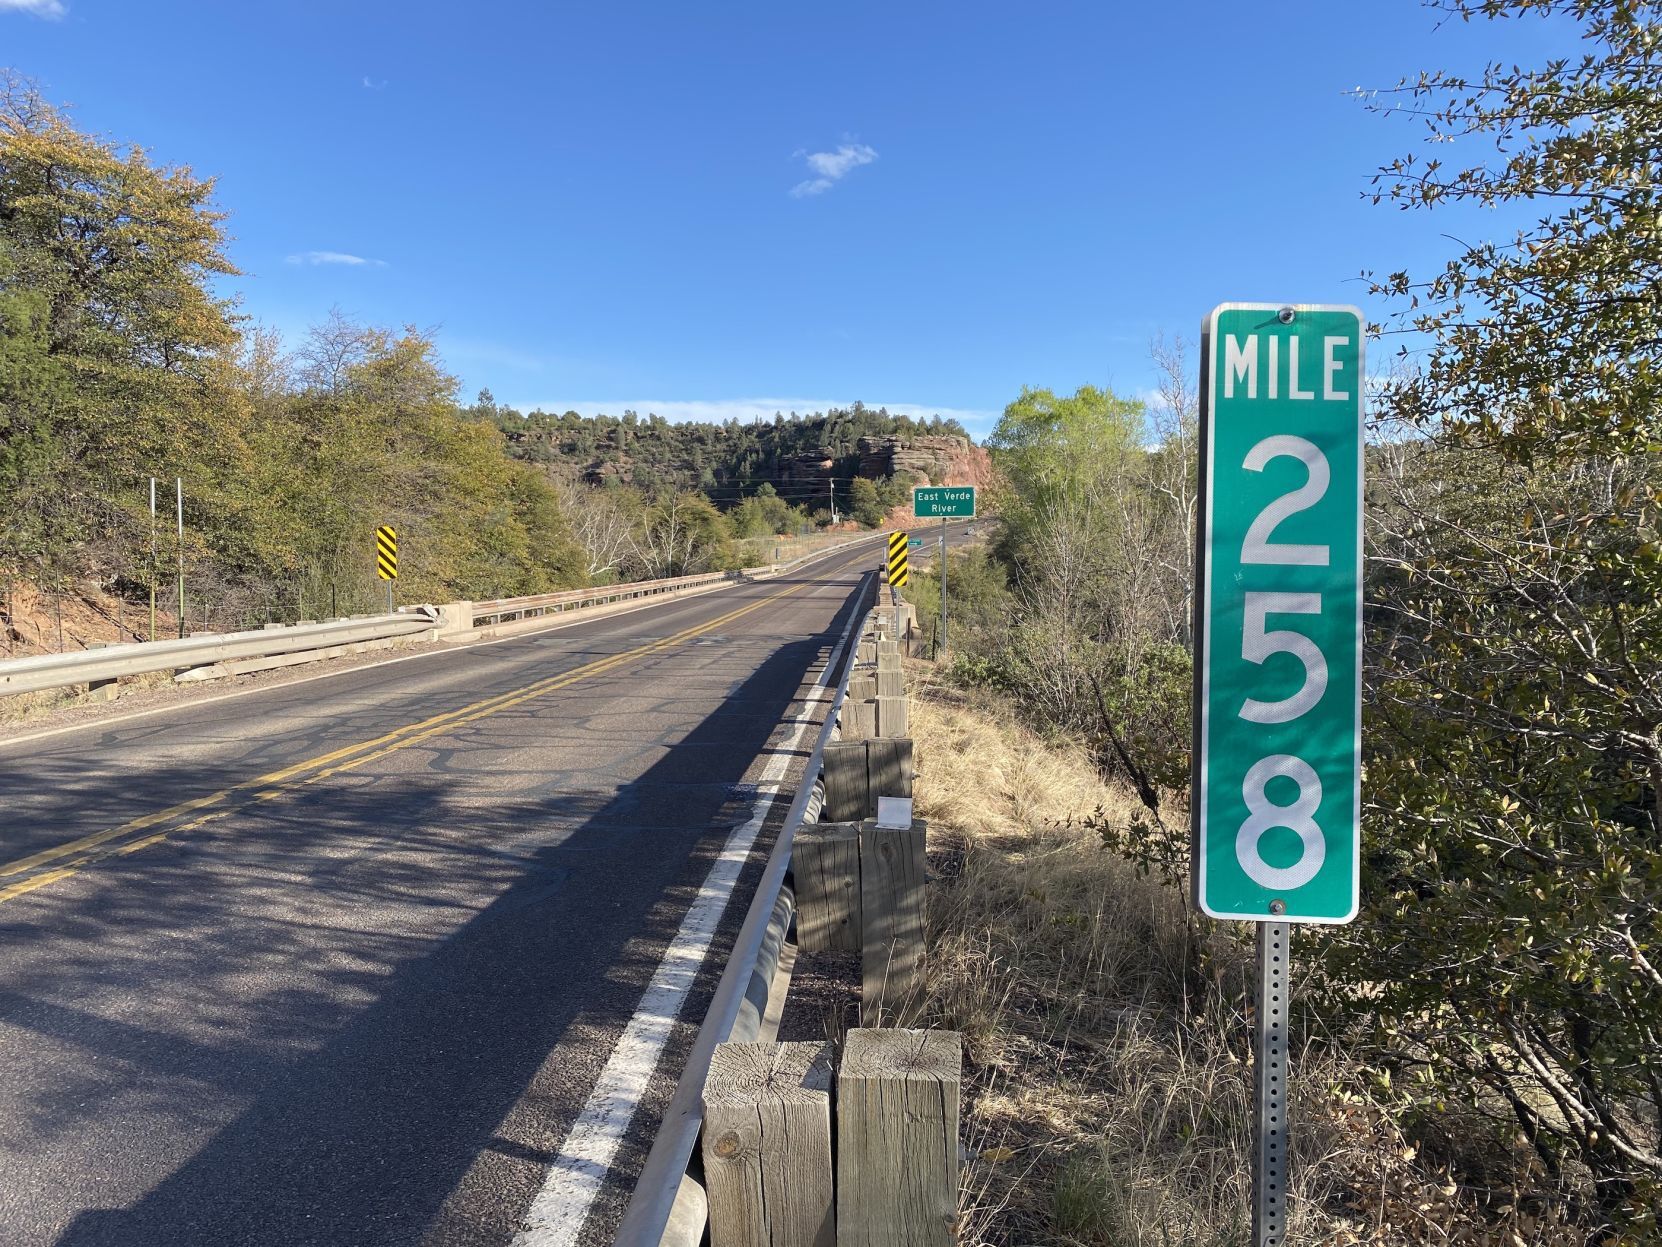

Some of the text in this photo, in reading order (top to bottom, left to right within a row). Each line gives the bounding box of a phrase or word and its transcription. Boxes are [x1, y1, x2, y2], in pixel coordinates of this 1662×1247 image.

[1224, 334, 1350, 401] MILE
[918, 492, 971, 501] East Verde
[931, 504, 957, 513] River
